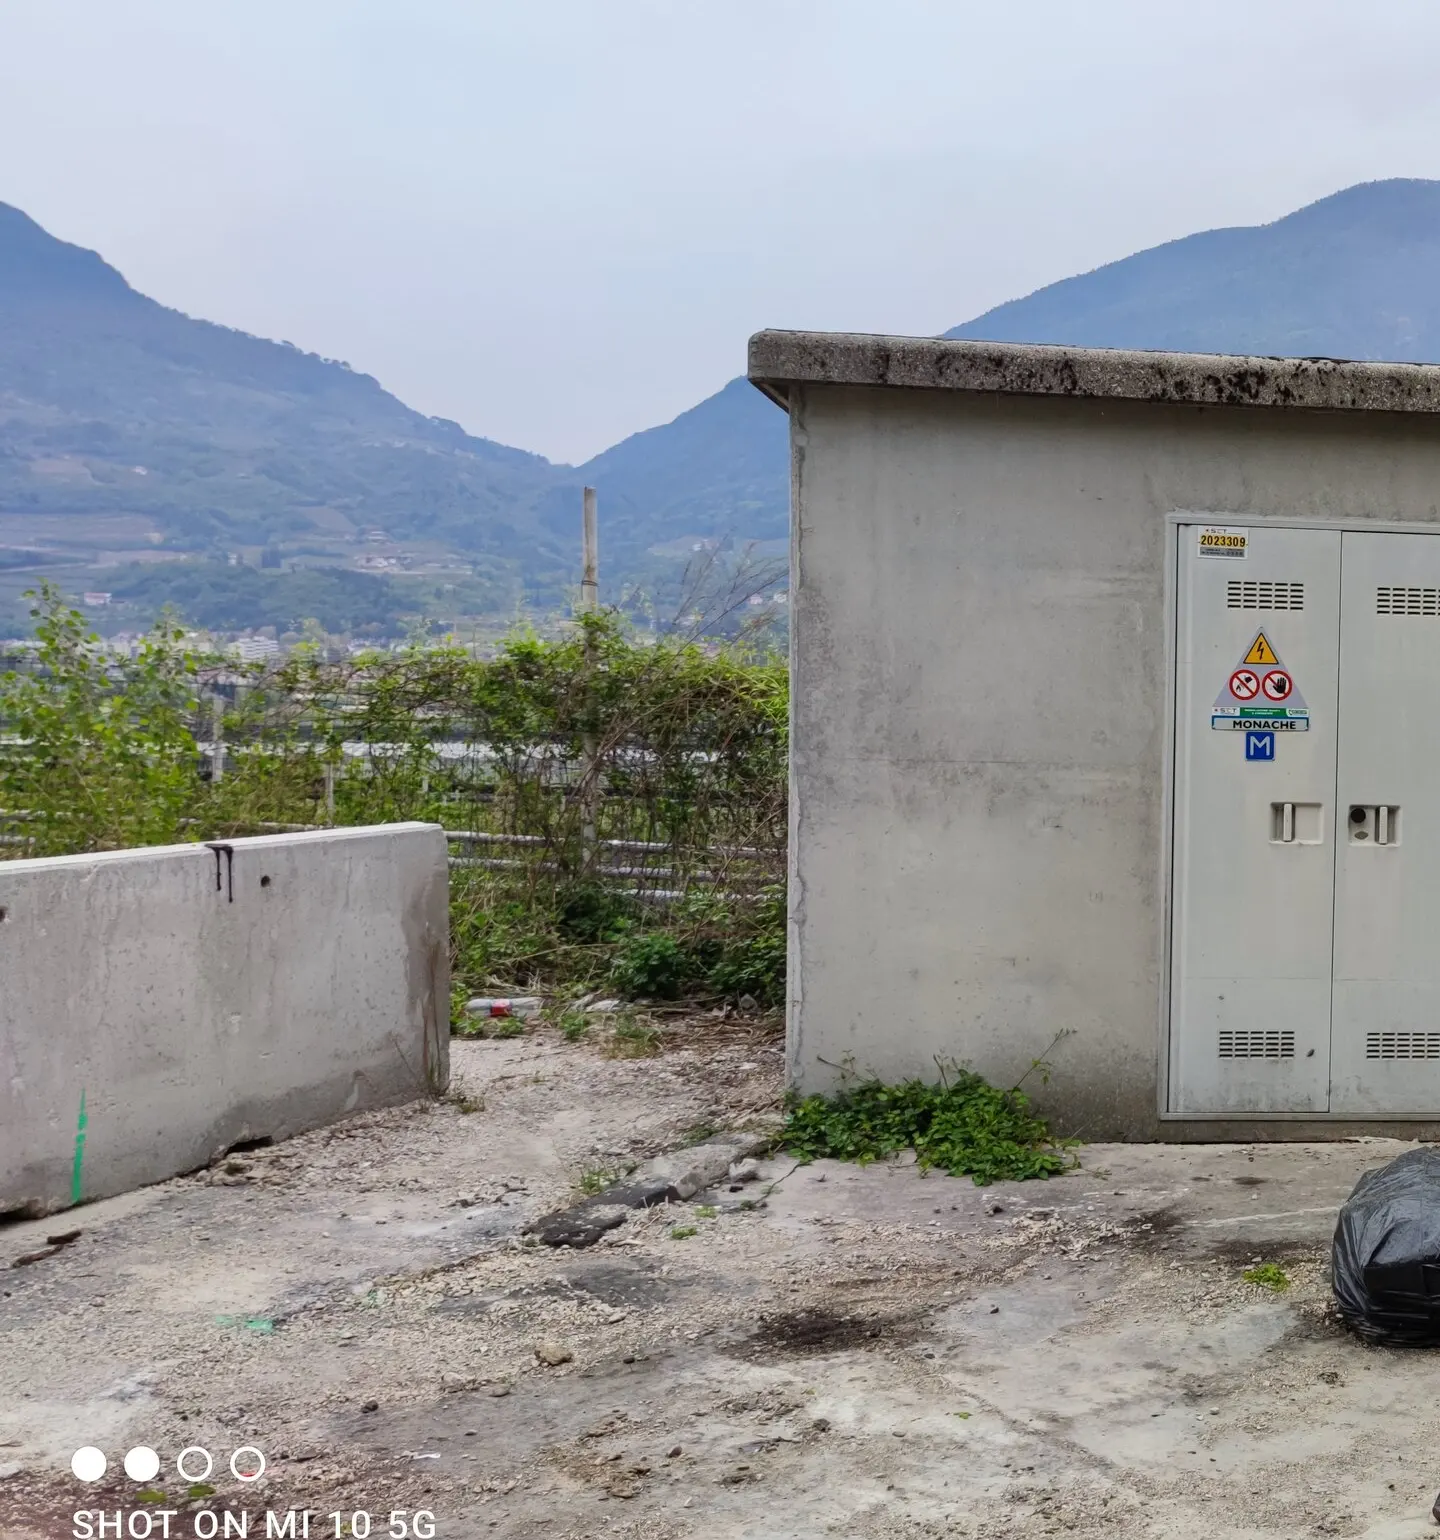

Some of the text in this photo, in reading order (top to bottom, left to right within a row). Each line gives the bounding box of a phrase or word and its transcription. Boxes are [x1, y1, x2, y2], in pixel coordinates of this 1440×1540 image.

[1200, 535, 1246, 547] 2023309
[1232, 720, 1297, 730] MONACHE
[1249, 735, 1271, 756] M
